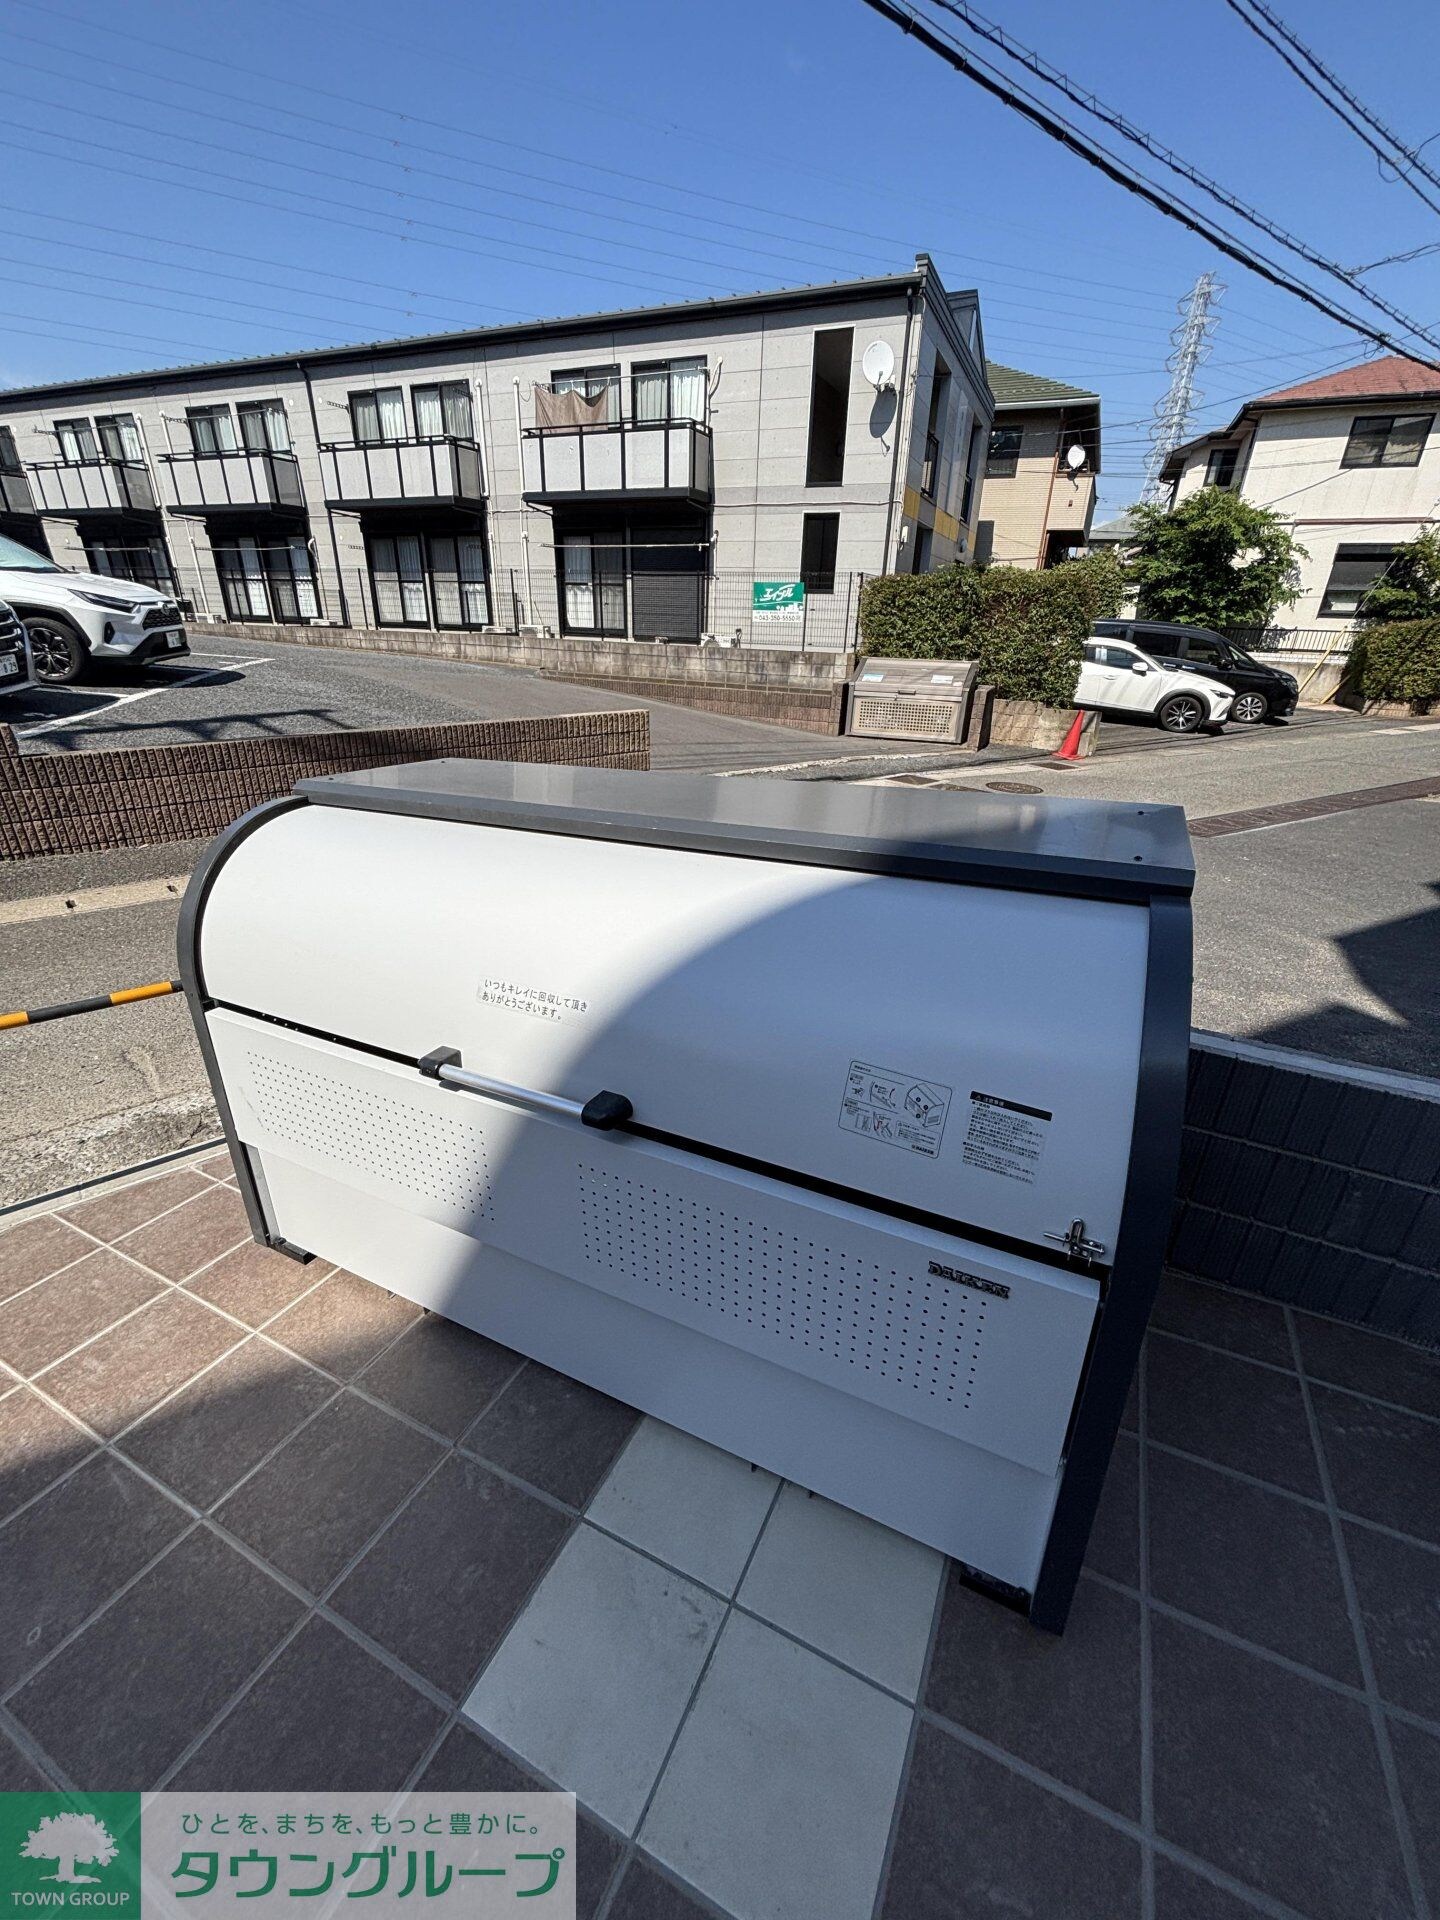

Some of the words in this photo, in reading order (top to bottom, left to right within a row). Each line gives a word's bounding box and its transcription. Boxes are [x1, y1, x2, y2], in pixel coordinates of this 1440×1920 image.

[482, 991, 562, 1020] ありがとうございます。
[484, 979, 588, 1012] いつもキレイに回収して頂き
[928, 1260, 1010, 1299] DAIKEN
